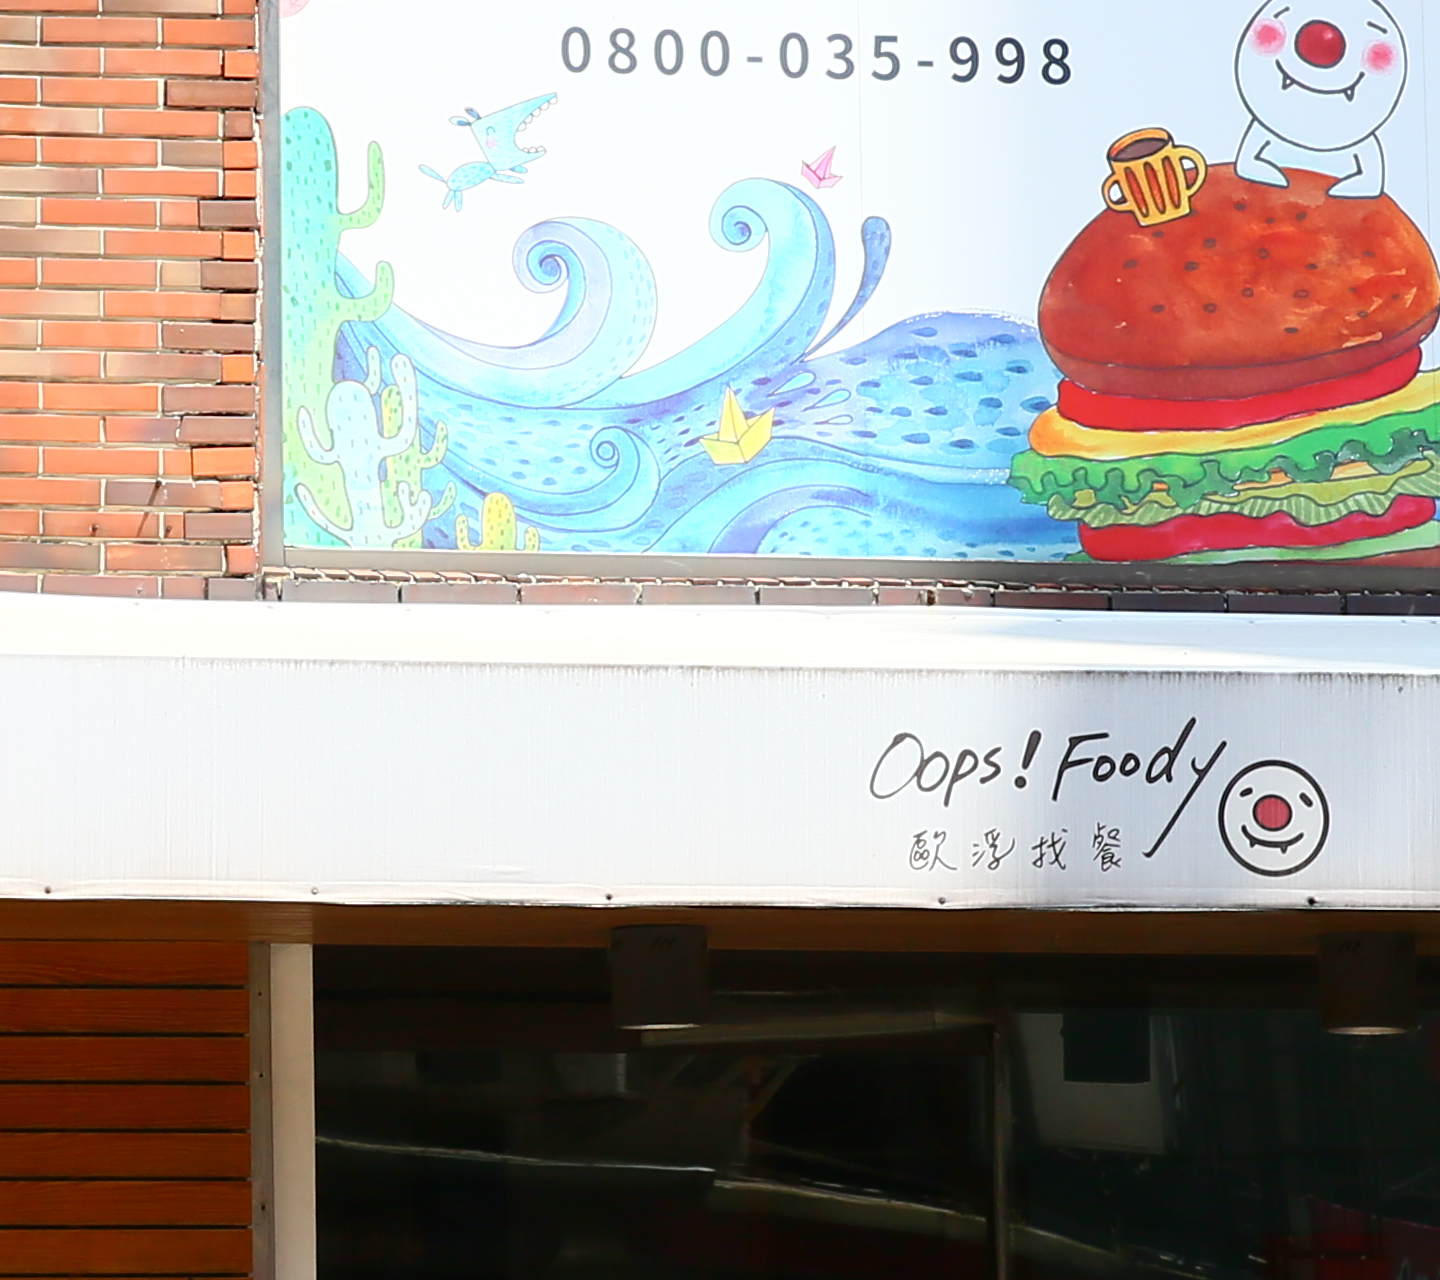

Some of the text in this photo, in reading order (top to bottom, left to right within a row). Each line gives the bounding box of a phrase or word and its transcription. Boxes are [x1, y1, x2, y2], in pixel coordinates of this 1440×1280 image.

[560, 25, 1075, 87] 0800-035-998
[868, 716, 1228, 859] Oops! Foody
[908, 821, 1123, 874] 歐浮找餐
